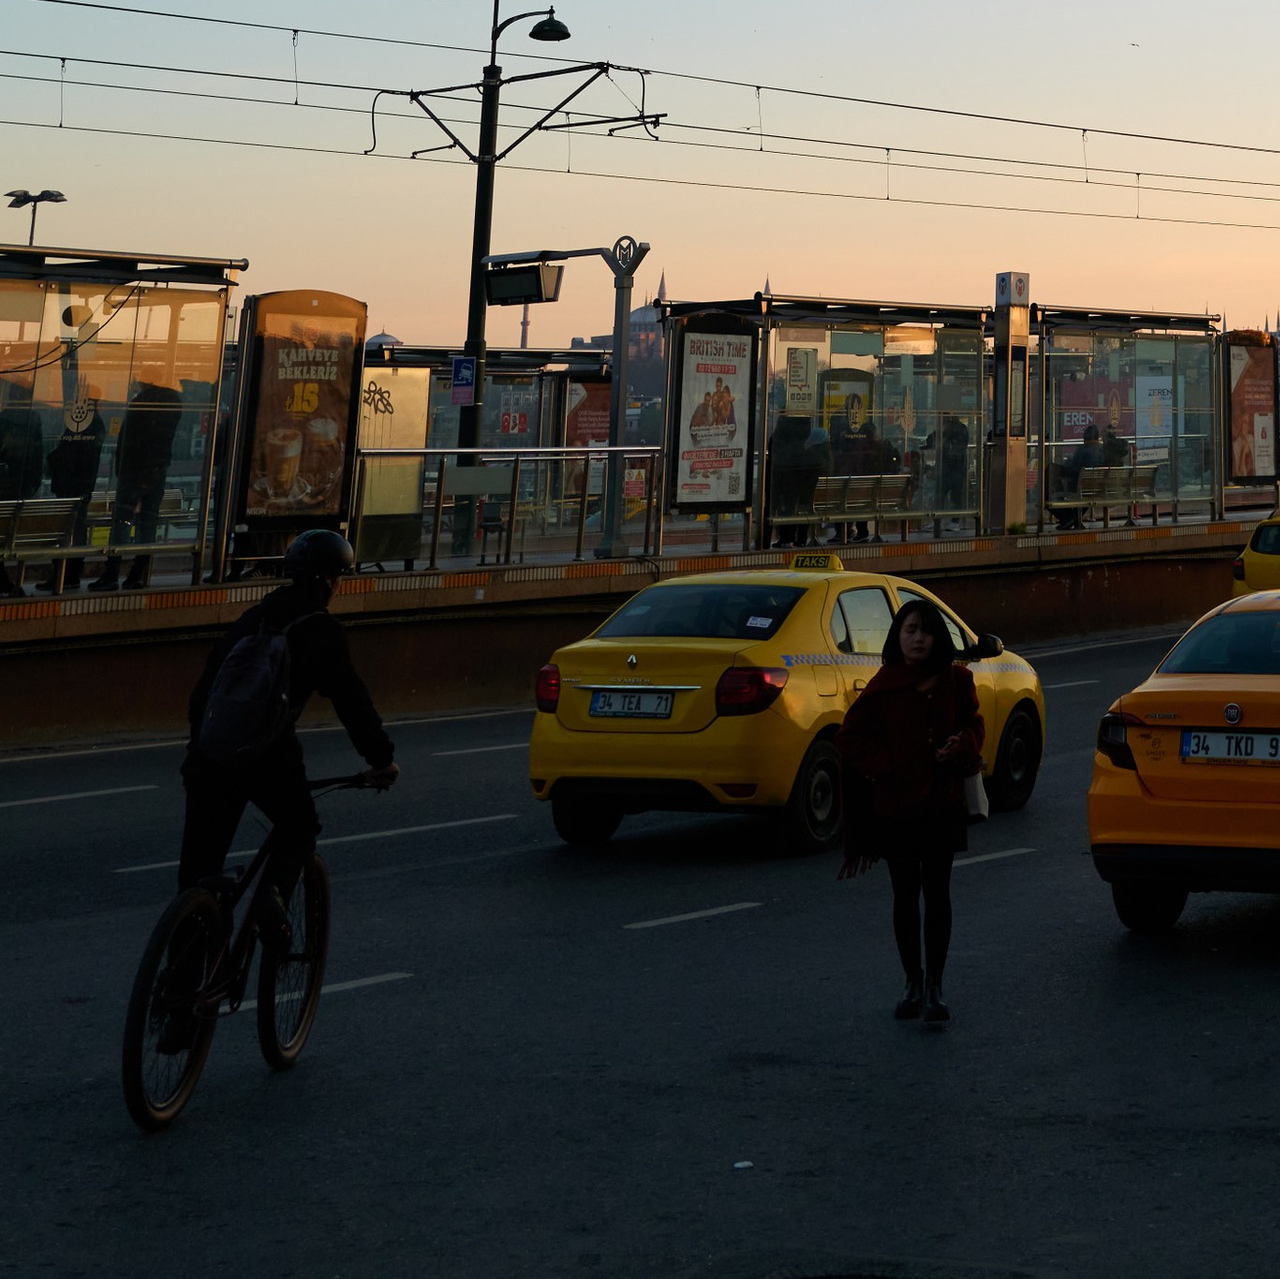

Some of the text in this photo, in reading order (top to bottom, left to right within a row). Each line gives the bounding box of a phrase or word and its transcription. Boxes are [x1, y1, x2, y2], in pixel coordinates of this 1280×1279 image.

[278, 349, 339, 366] KAHVEYE
[278, 362, 337, 381] BEKLERİZ
[1064, 412, 1093, 426] EREN
[599, 694, 670, 712] 34 TEA 71
[1191, 735, 1210, 754] 34
[1226, 736, 1254, 756] TKD
